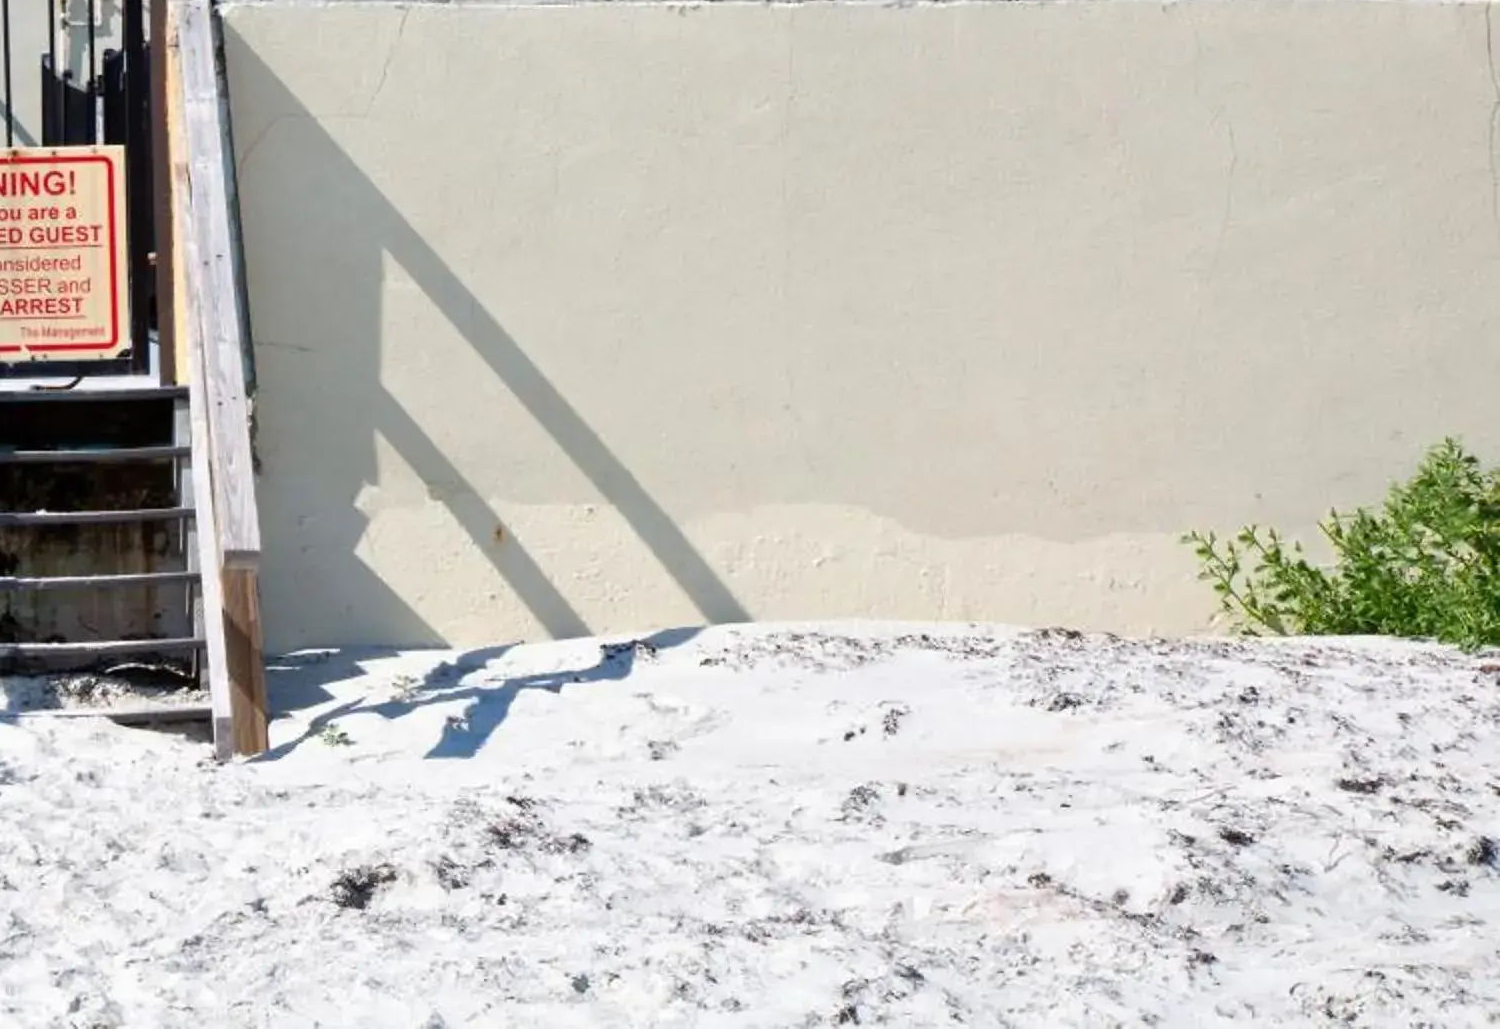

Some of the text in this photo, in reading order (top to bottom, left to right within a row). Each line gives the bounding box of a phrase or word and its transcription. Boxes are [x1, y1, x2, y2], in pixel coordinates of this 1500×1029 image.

[28, 207, 61, 219] are
[66, 207, 76, 219] a
[30, 226, 103, 243] GUEST
[58, 278, 90, 293] and
[0, 299, 84, 315] ARREST
[21, 326, 105, 340] The Management
